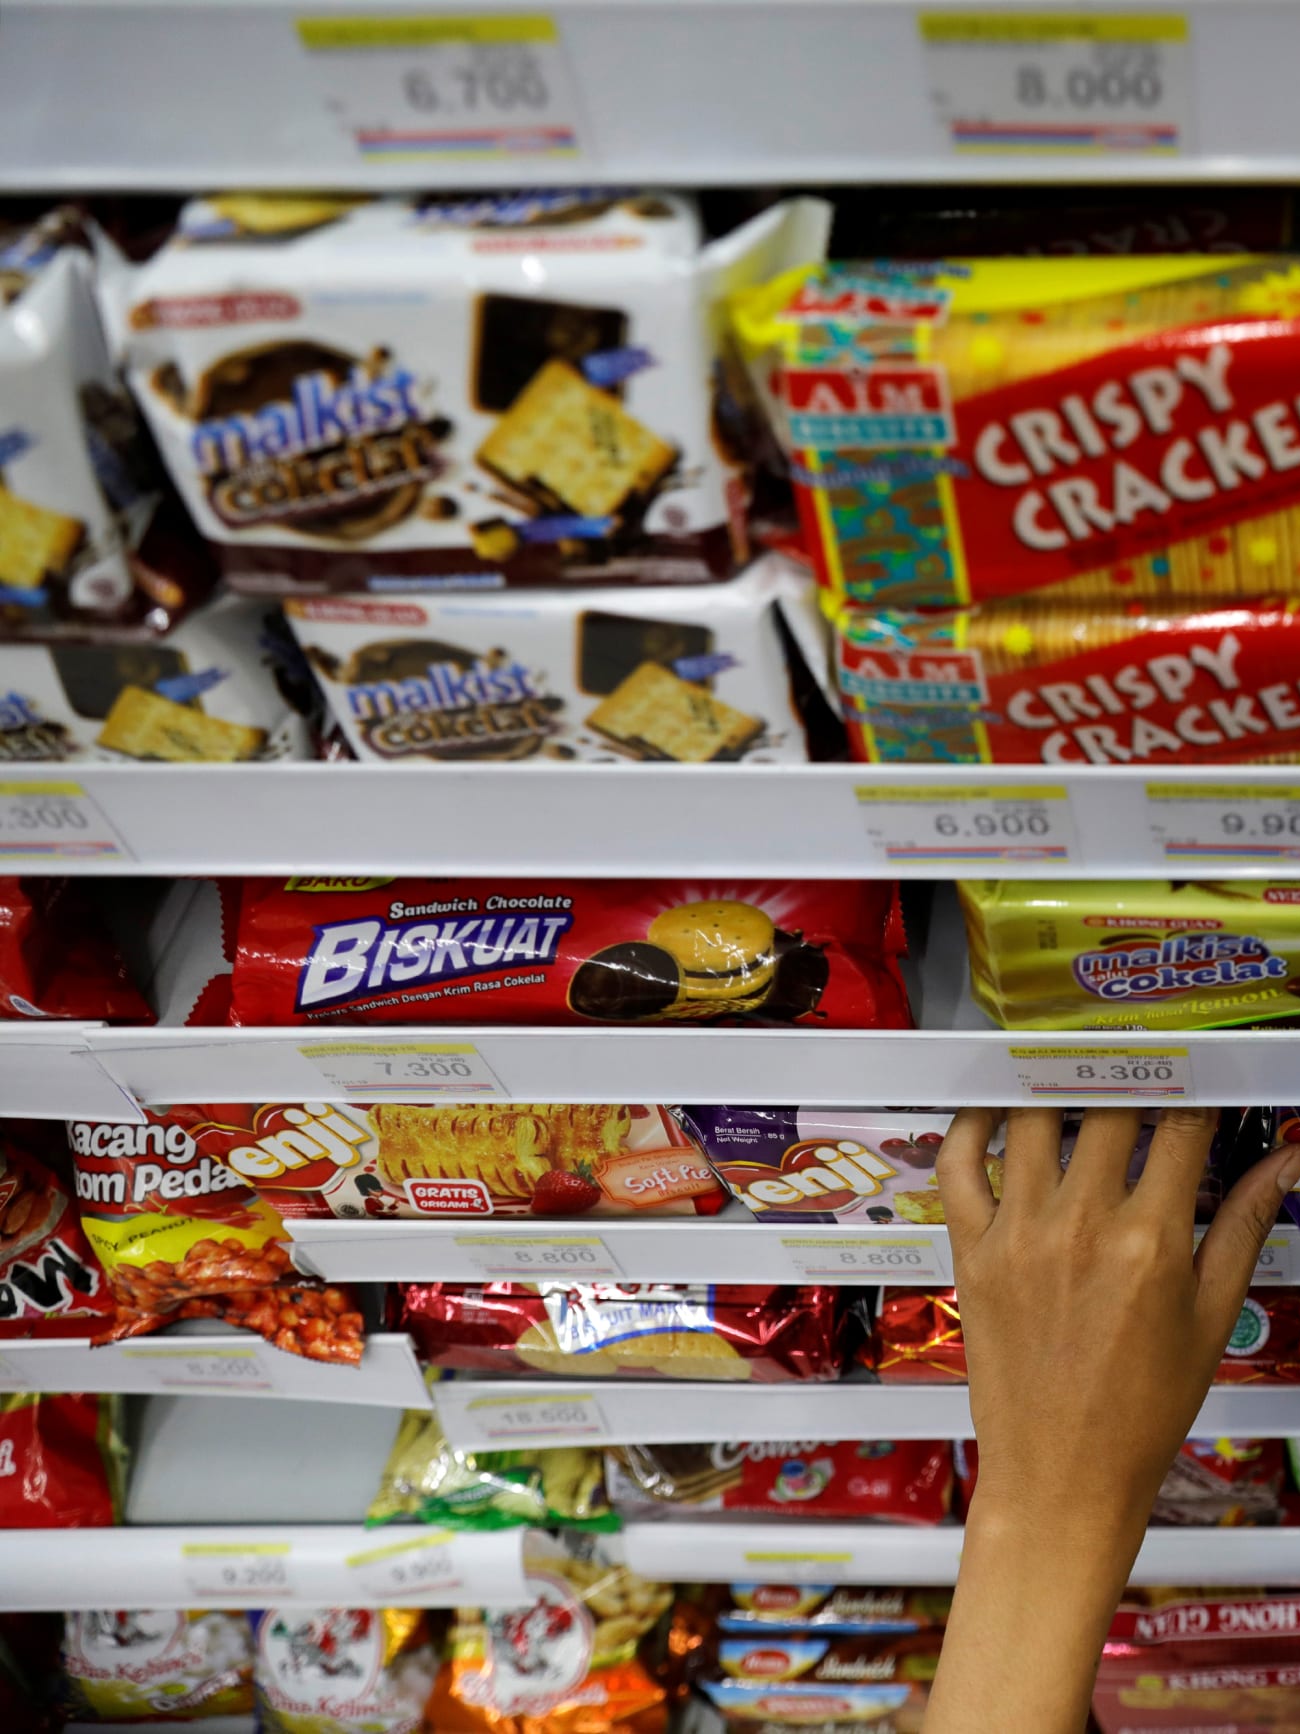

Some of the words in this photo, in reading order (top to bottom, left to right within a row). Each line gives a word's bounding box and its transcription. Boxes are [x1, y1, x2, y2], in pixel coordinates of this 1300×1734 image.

[403, 67, 549, 113] 6.700
[1014, 66, 1164, 107] 8.000
[190, 366, 420, 474] malkist
[975, 344, 1233, 486] CRISPY
[347, 657, 533, 719] malkist
[1007, 633, 1243, 729] CRISPY
[935, 813, 1051, 837] 6.900
[390, 899, 479, 920] Sandwich
[485, 894, 573, 911] Chocolate
[300, 917, 568, 1006] BISKUAT
[1081, 935, 1262, 975] malkist
[402, 989, 442, 1004] Dengan
[443, 985, 472, 997] Krim
[474, 979, 502, 993] Rasa
[504, 973, 546, 988] Cokelat
[1099, 956, 1288, 998] cokelat
[374, 1060, 473, 1078] 7.300
[1075, 1064, 1174, 1081] 8.300
[229, 1103, 372, 1177] enji
[714, 1126, 735, 1135] Berat
[736, 1127, 761, 1135] Bersih
[767, 1132, 779, 1140] 85
[415, 1184, 480, 1200] GRATIS
[624, 1167, 679, 1195] Soft
[678, 1163, 712, 1180] Pie
[420, 1199, 470, 1210] ORIGAMI
[513, 1250, 597, 1264] 8.800
[839, 1252, 923, 1265] 8.800
[1168, 1669, 1269, 1690] KHONG
